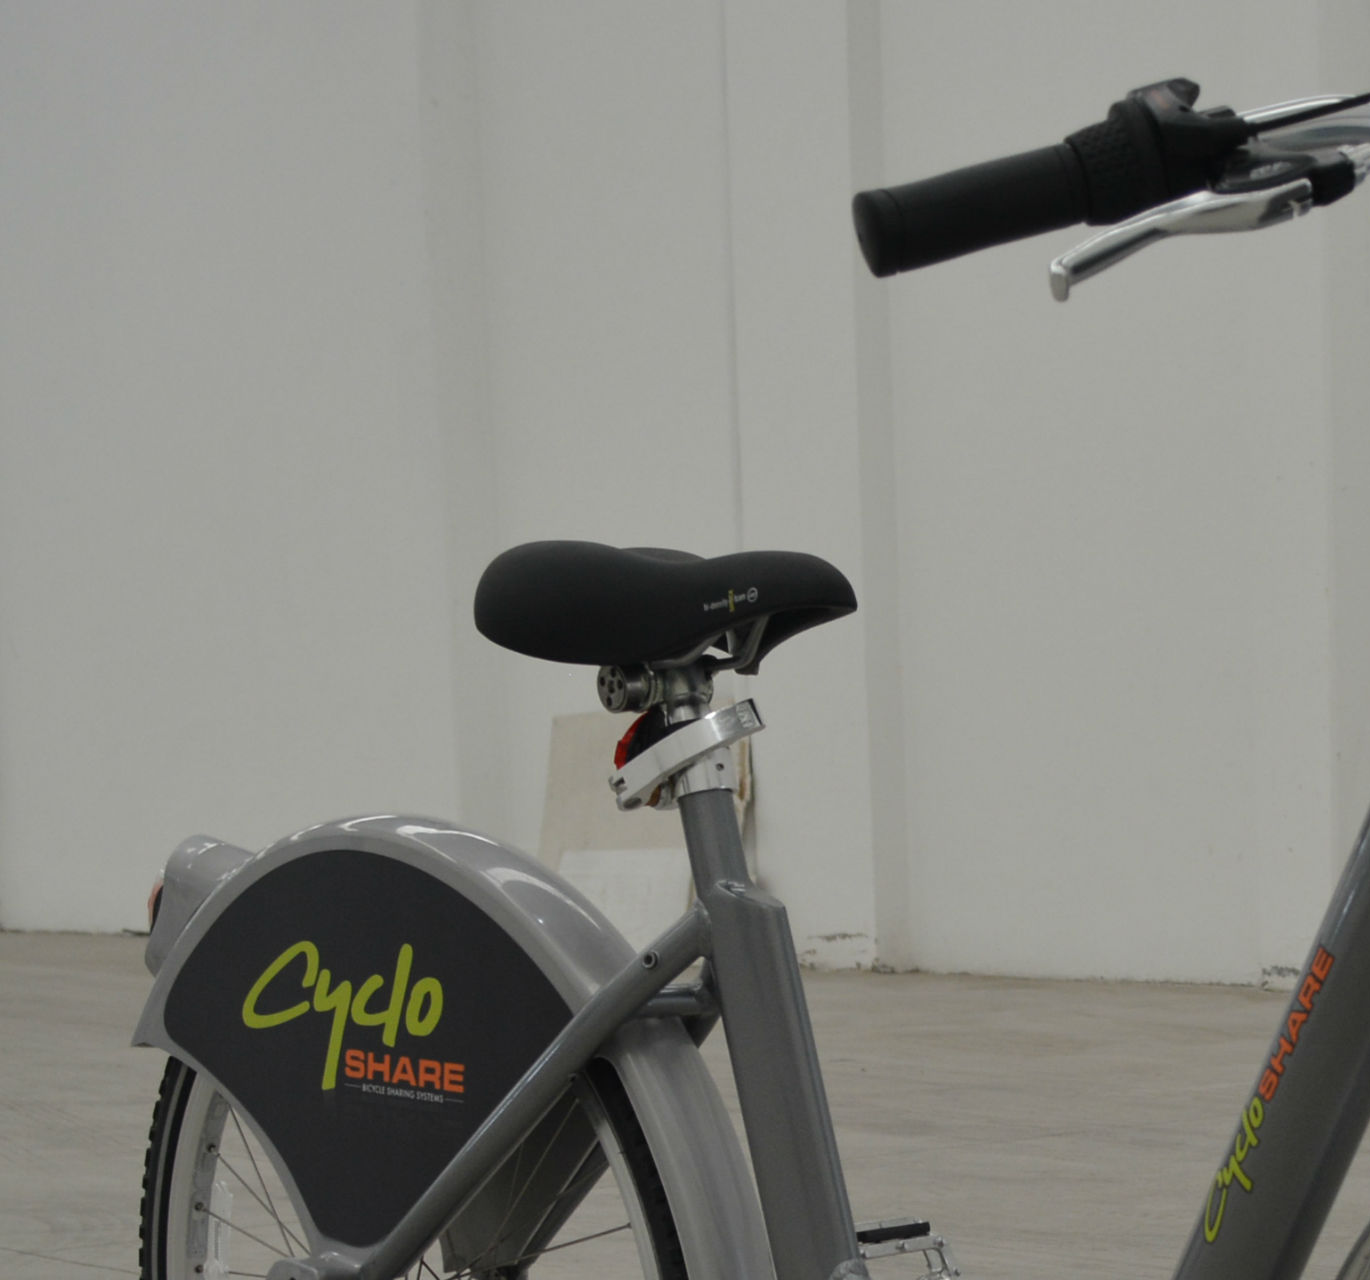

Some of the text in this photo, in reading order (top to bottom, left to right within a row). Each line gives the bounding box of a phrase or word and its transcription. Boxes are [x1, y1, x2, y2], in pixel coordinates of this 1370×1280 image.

[241, 940, 444, 1091] Cyclo
[344, 1048, 465, 1094] SHARE
[362, 1083, 385, 1095] BICYCLE
[387, 1086, 415, 1100] SHARING
[1204, 946, 1335, 1243] Cyclo SHARE
